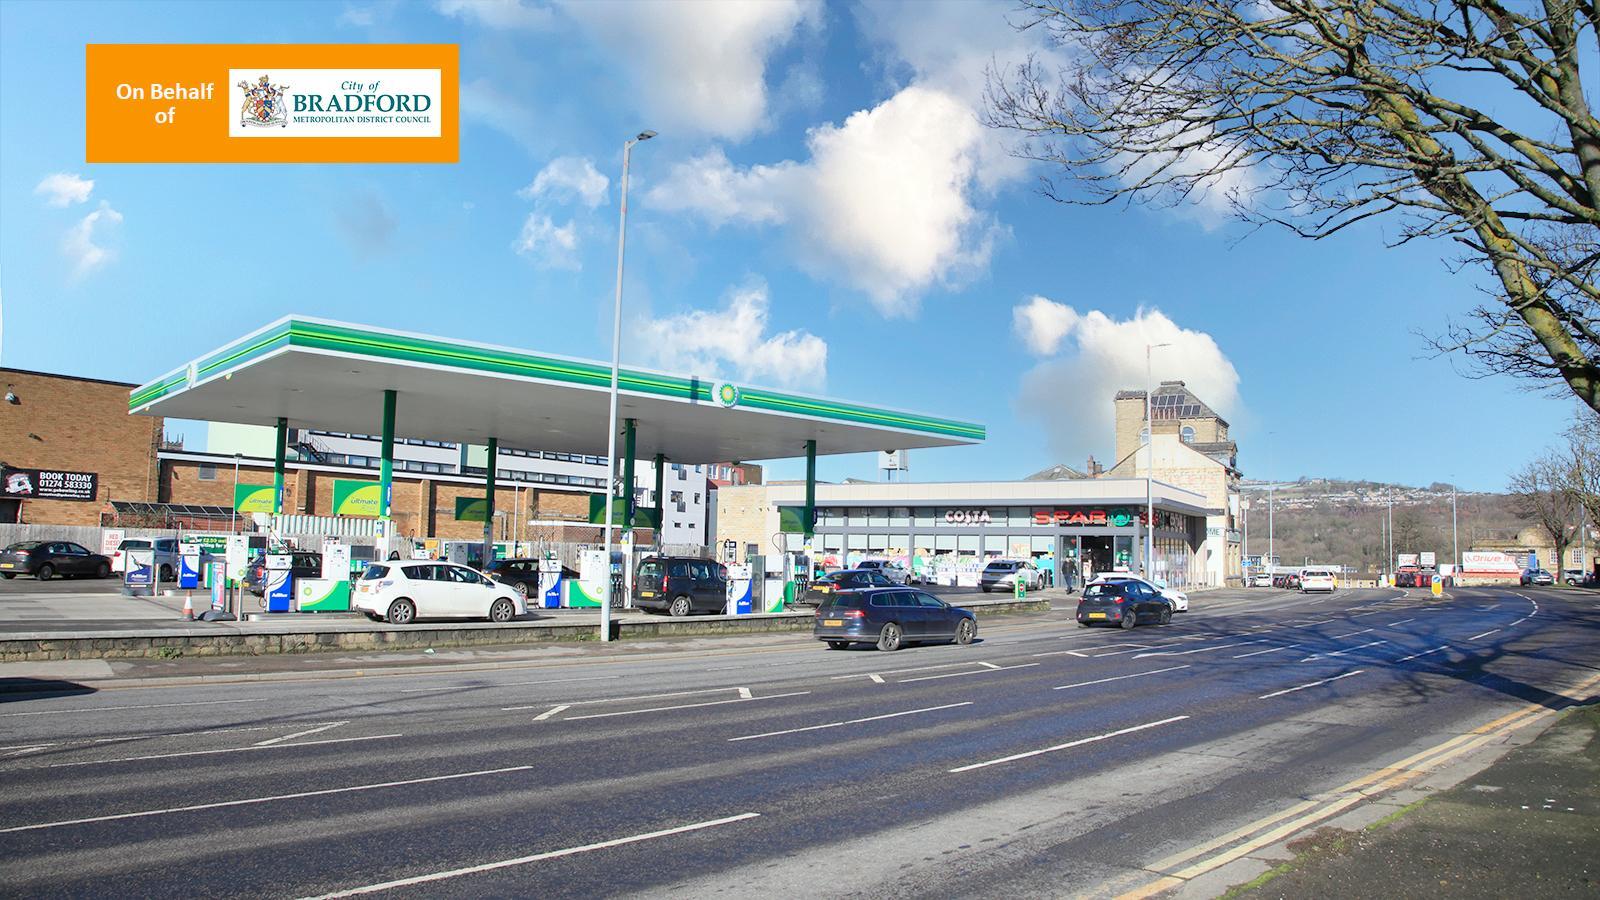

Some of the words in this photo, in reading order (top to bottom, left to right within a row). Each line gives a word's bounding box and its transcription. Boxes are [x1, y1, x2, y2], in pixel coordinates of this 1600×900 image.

[39, 471, 64, 481] BOOK
[65, 473, 92, 482] TODAY
[39, 479, 63, 488] 01274
[64, 481, 92, 490] 583330
[944, 508, 992, 524] COSTA
[1034, 511, 1108, 525] SPAR
